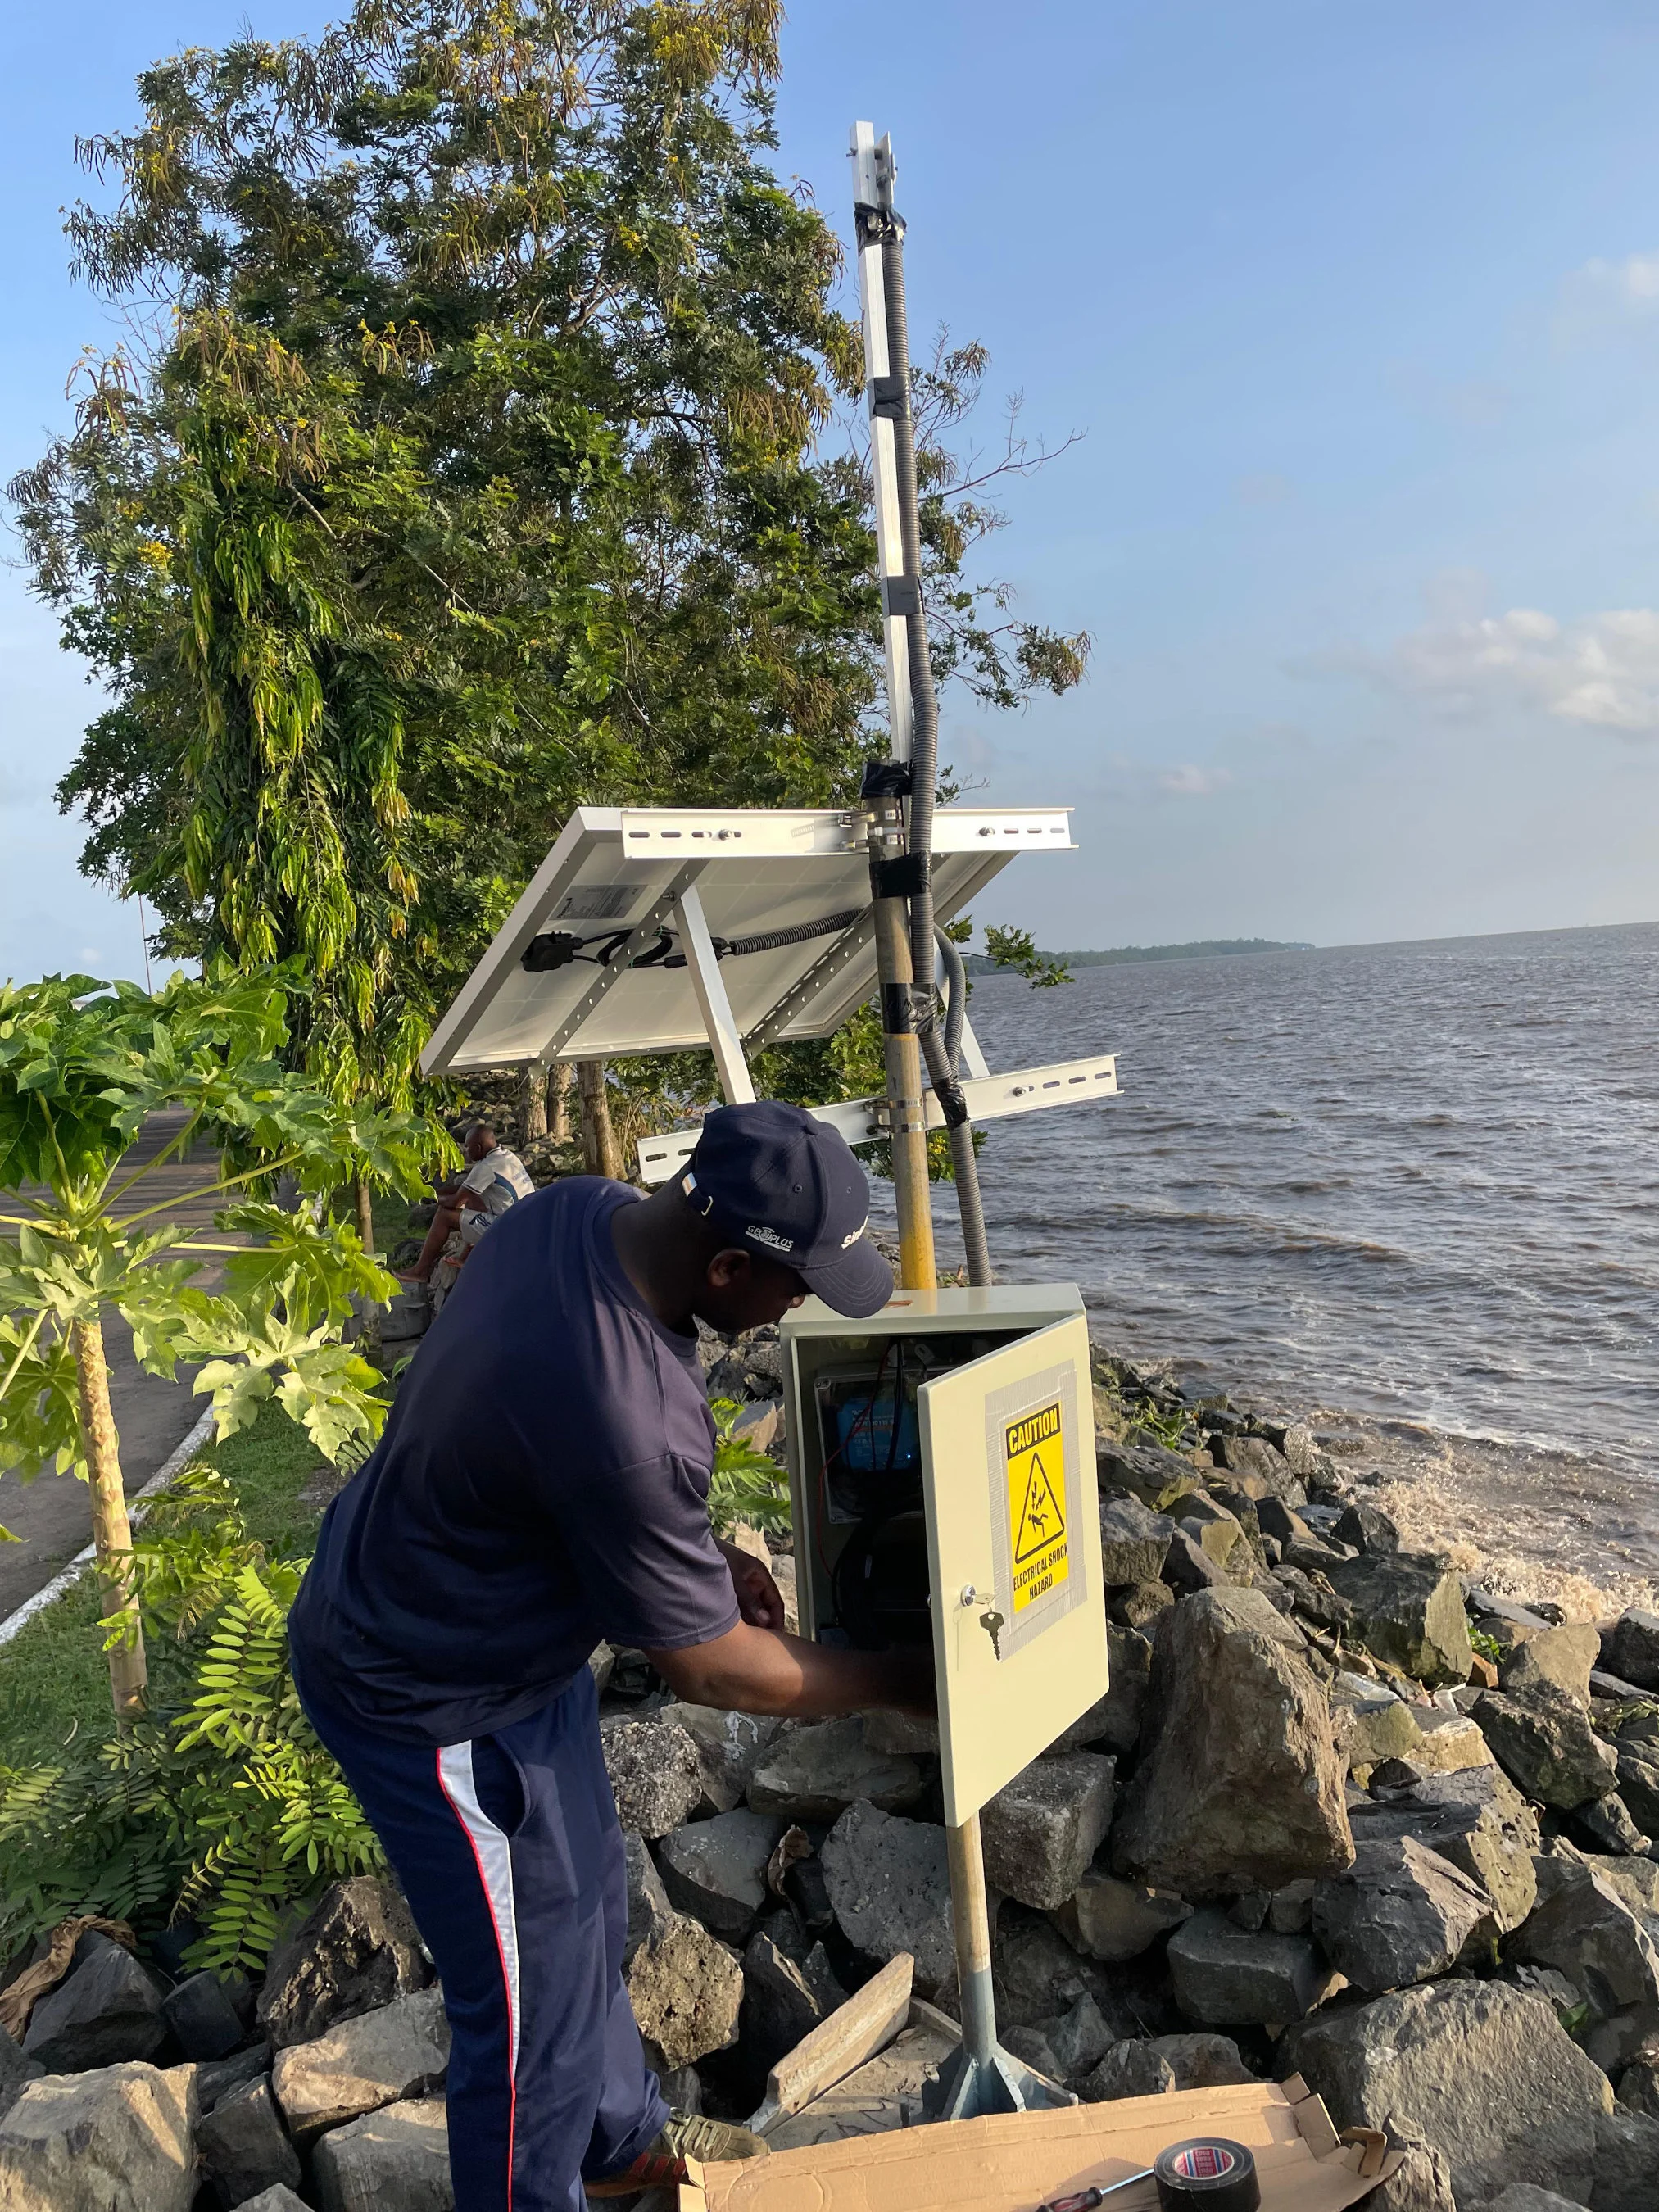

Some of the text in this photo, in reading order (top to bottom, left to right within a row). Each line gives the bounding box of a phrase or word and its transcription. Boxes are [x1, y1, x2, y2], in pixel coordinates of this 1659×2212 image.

[746, 1225, 794, 1249] GEOPLUS
[1009, 1407, 1058, 1454] CAUTION
[1013, 1542, 1068, 1592] ELECTRICAL SHOCK
[1029, 1573, 1054, 1601] HAZARD
